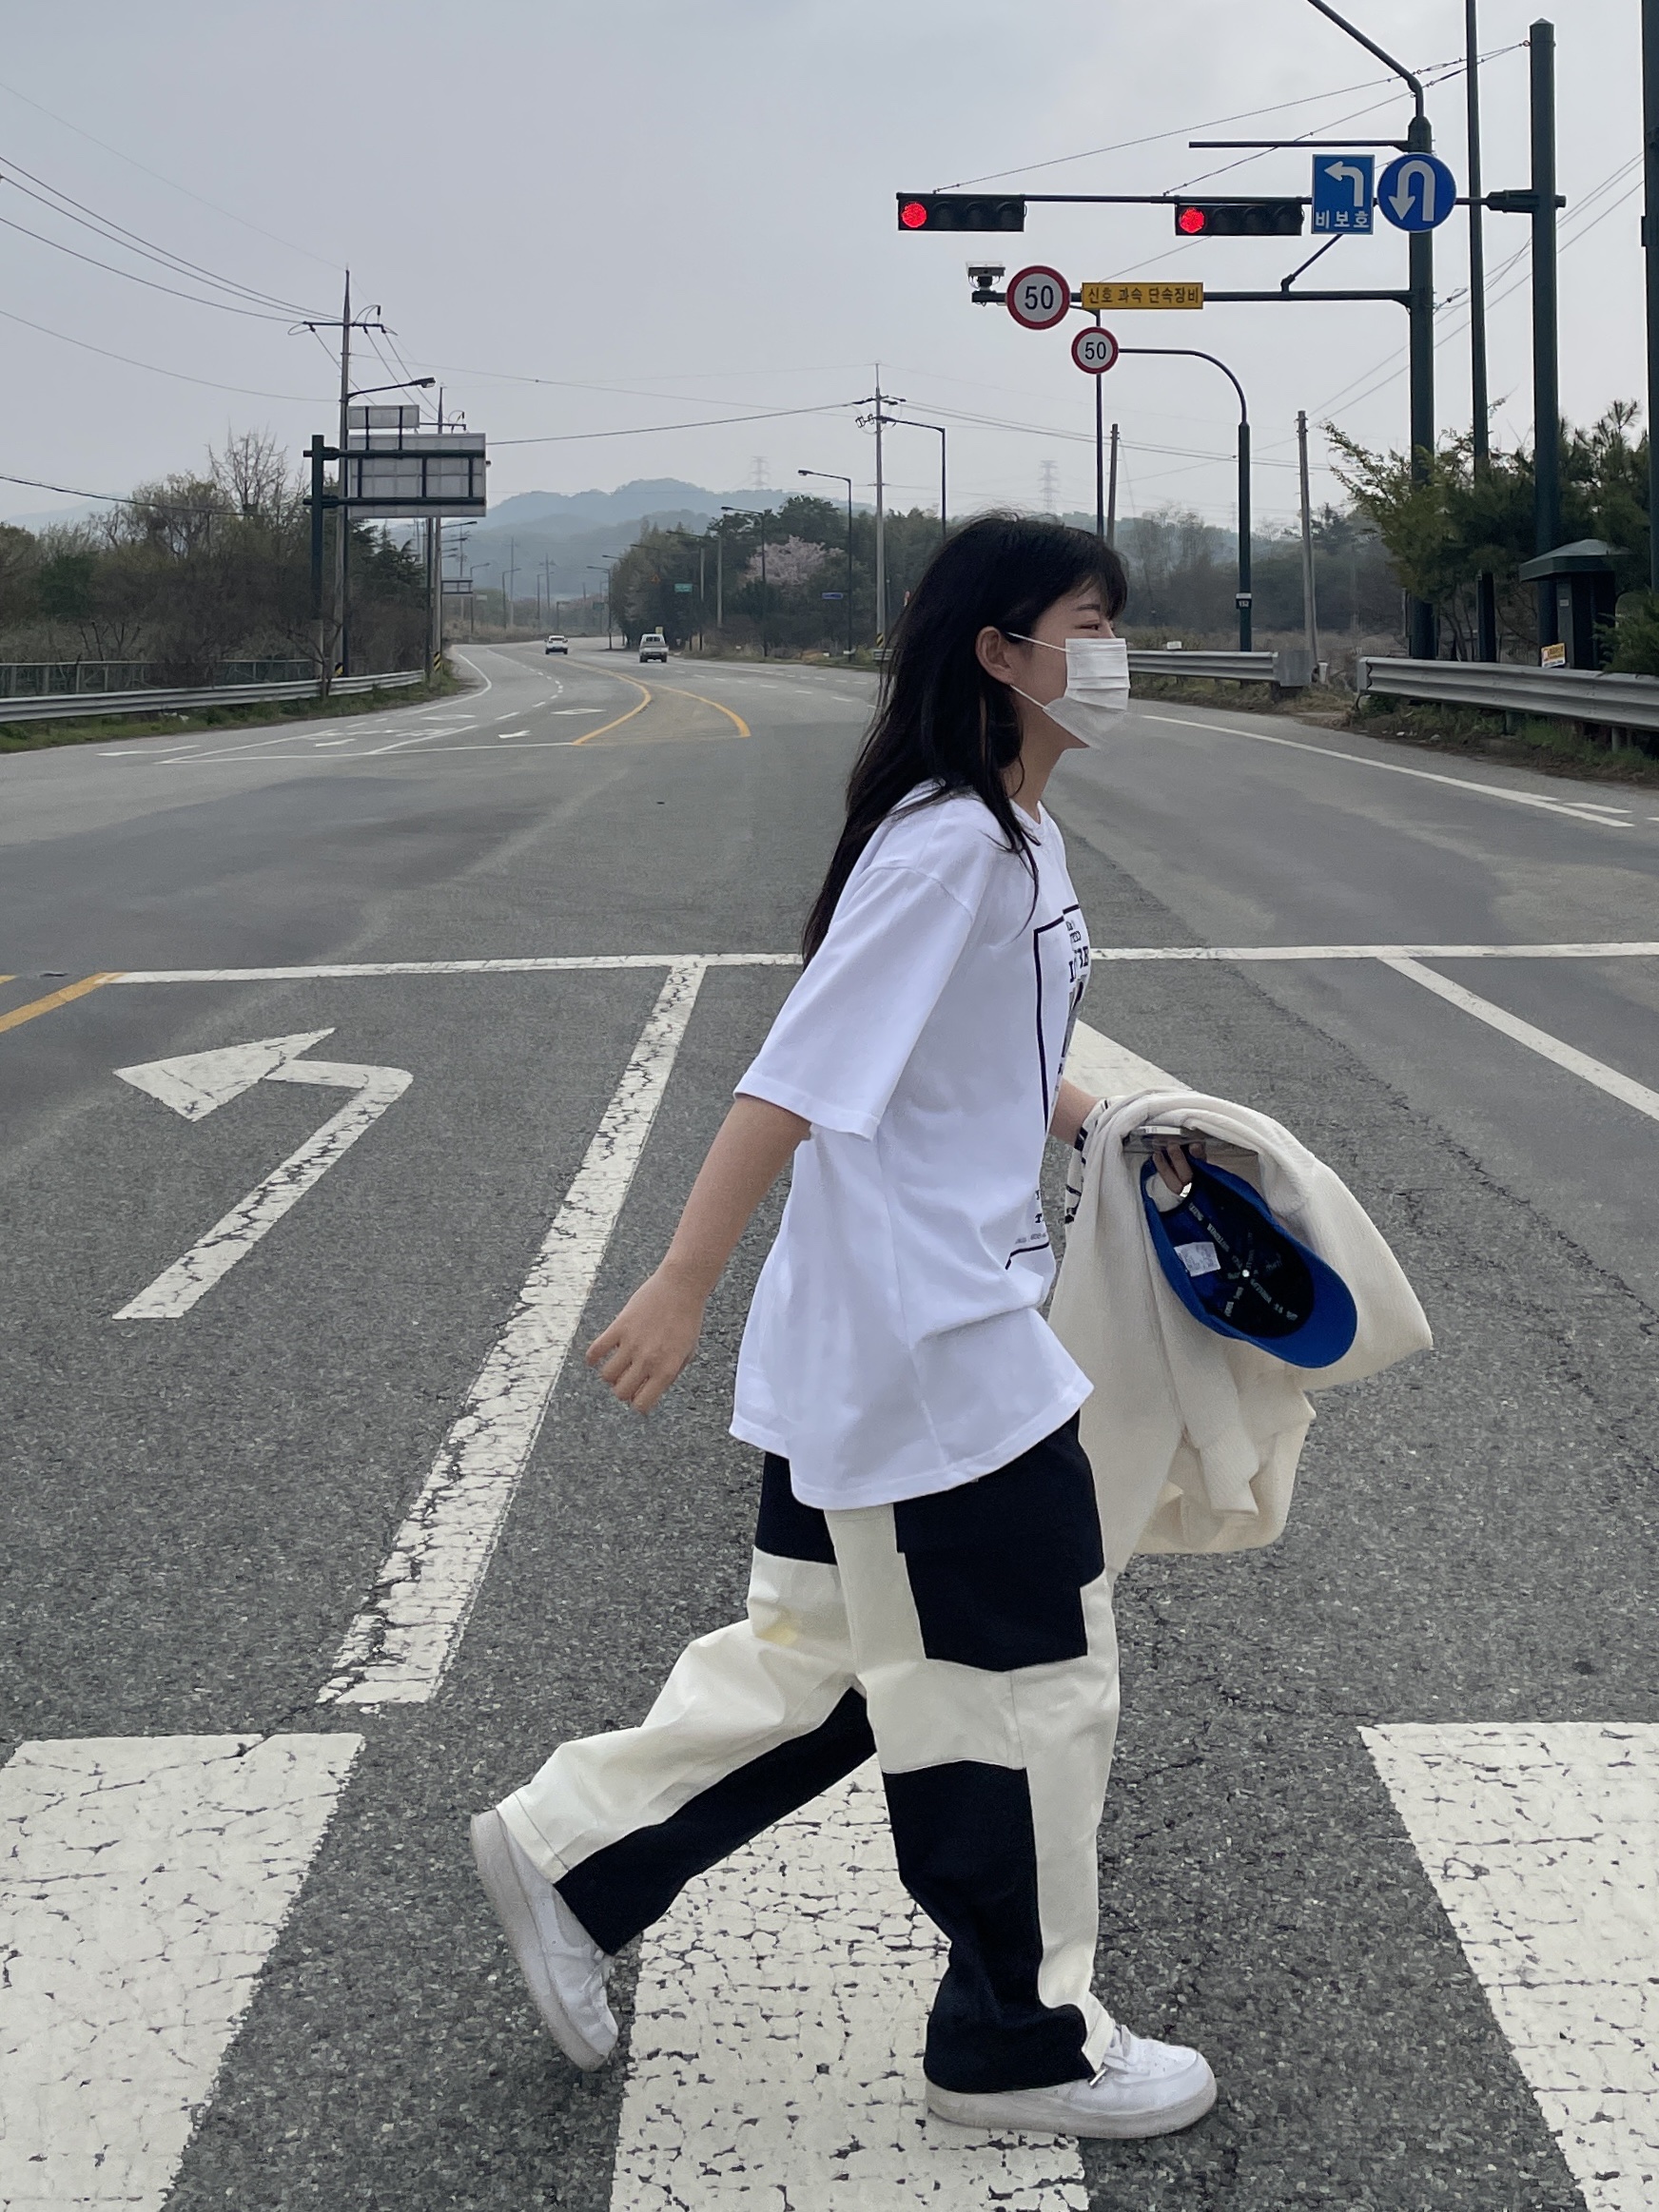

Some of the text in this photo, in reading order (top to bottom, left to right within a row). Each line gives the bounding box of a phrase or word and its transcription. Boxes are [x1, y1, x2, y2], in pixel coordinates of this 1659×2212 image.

[1315, 209, 1370, 229] 비보호
[1025, 285, 1054, 310] 50
[1088, 286, 1199, 304] 신호 과속 단속장비
[1084, 341, 1106, 359] 50
